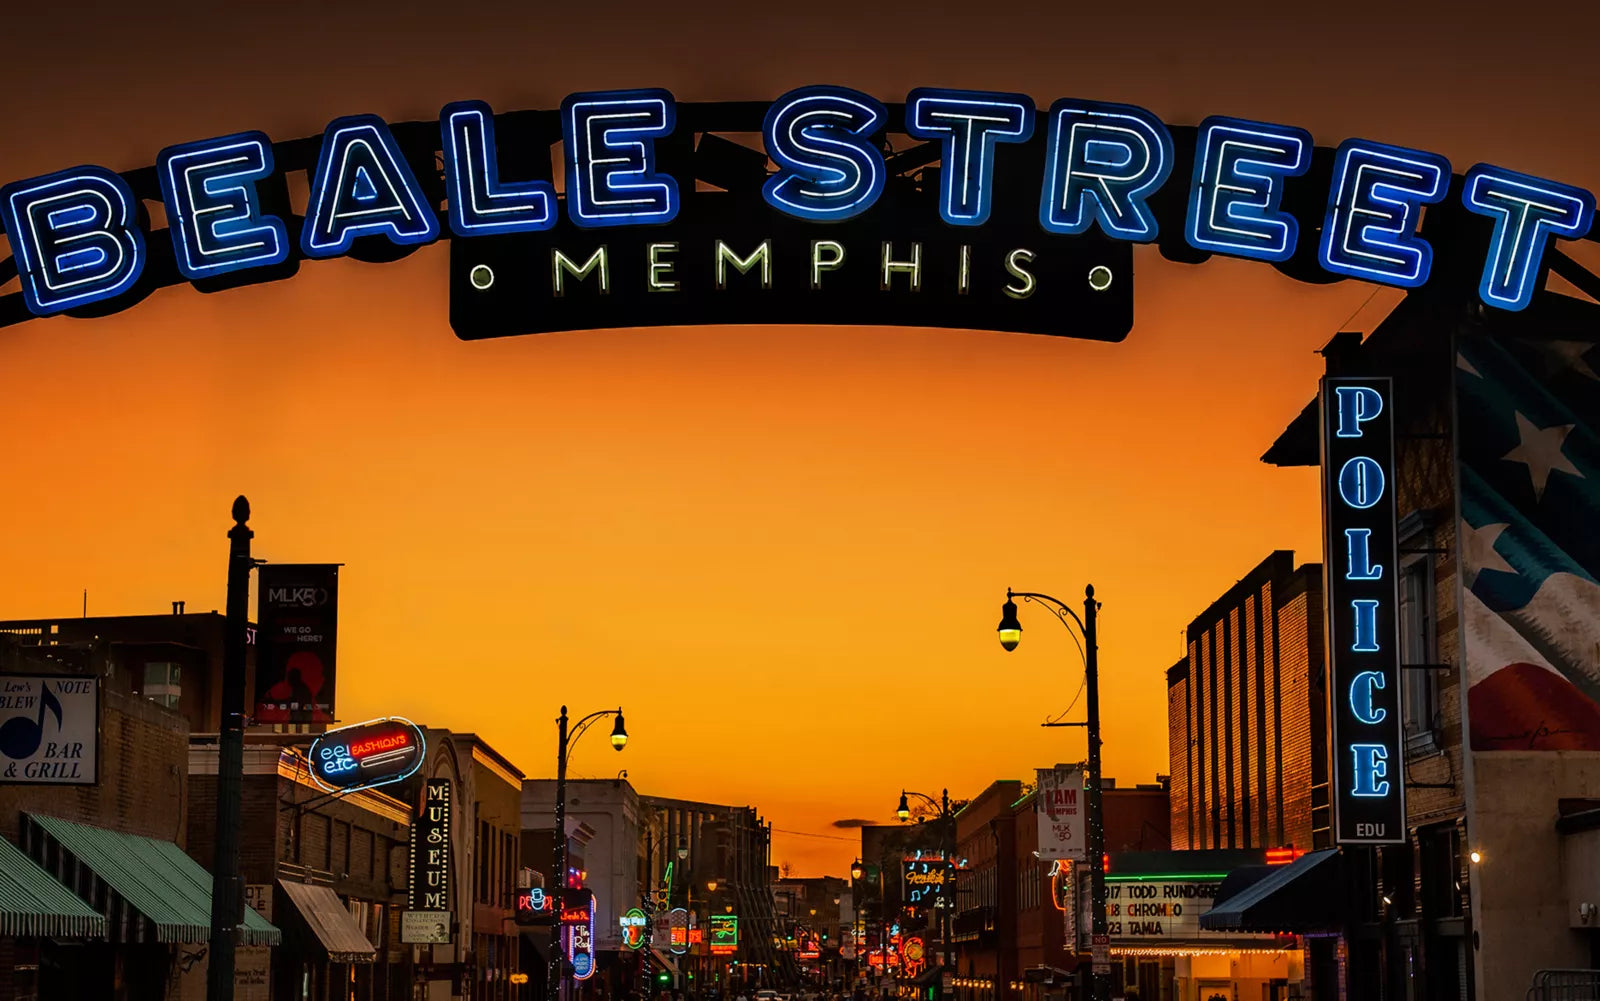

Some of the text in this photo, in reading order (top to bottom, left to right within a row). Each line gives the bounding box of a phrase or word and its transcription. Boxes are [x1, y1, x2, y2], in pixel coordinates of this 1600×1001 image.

[0, 85, 1597, 317] BEALE STREET
[551, 239, 1037, 299] MEMPHIS
[1334, 385, 1391, 798] POLICE
[298, 626, 312, 634] GO
[4, 682, 31, 693] Lew's
[55, 681, 91, 694] NOTE
[0, 696, 37, 709] BLEW
[45, 742, 83, 759] BAR
[351, 735, 408, 757] FASHIONS
[4, 761, 82, 779] & GRILL
[1054, 789, 1077, 805] AM
[1355, 823, 1386, 837] EDU
[425, 785, 445, 908] MUSEUM
[1127, 885, 1157, 899] TODD
[1127, 903, 1183, 917] CHROMEO
[1128, 921, 1164, 935] TAMIA
[1094, 936, 1107, 944] NO
